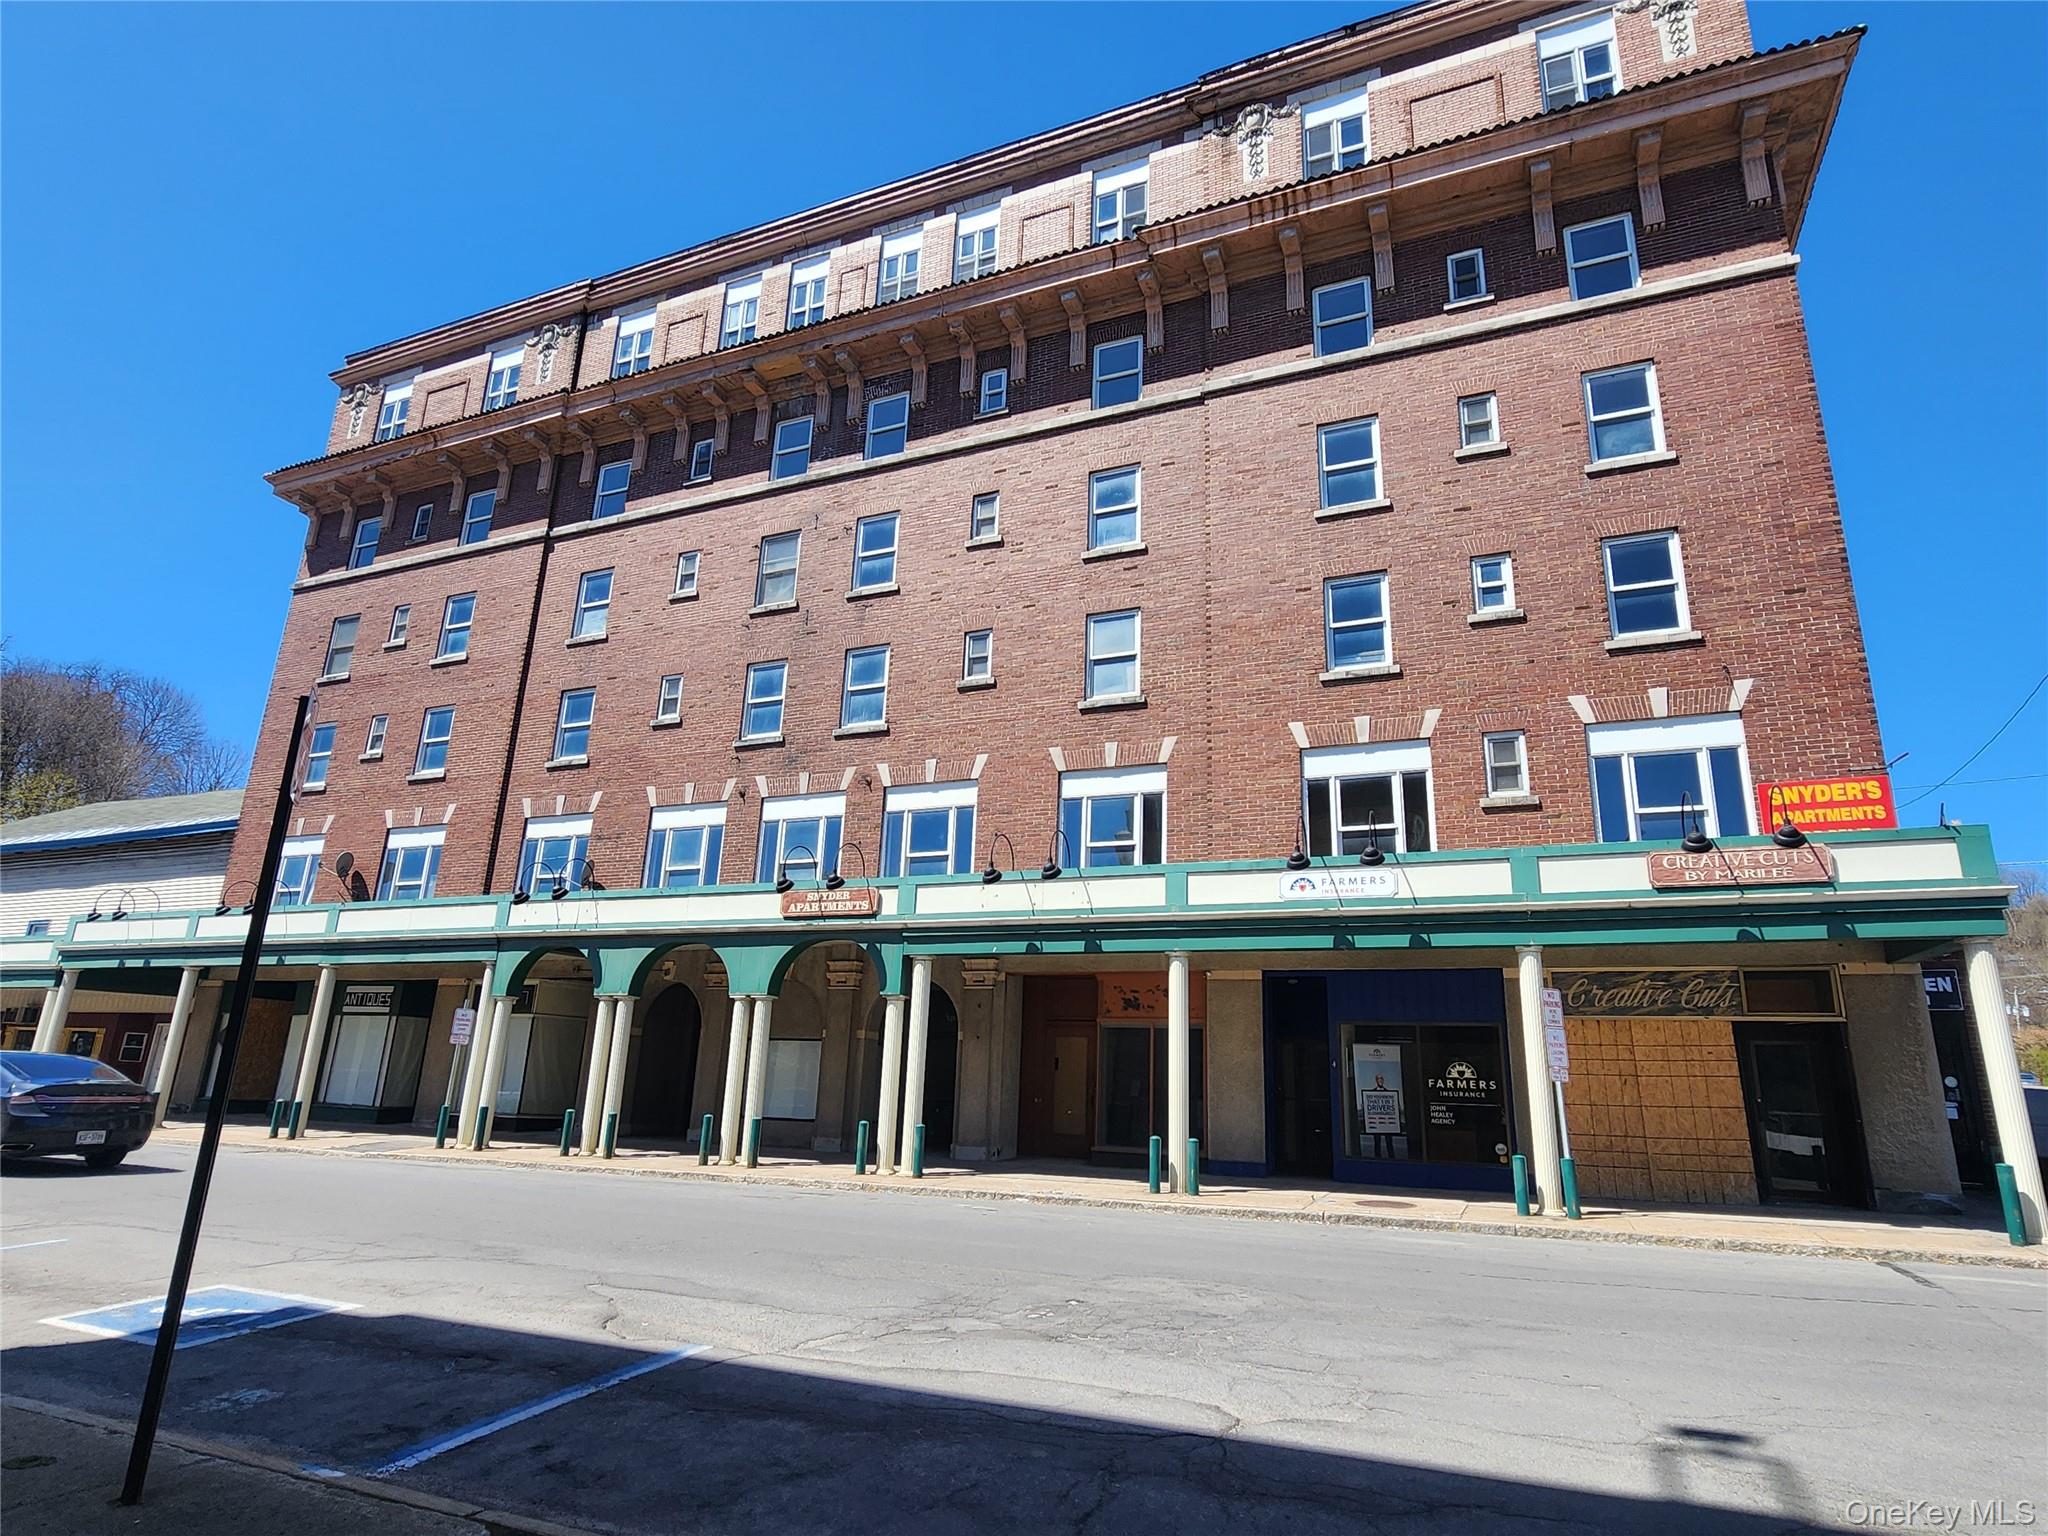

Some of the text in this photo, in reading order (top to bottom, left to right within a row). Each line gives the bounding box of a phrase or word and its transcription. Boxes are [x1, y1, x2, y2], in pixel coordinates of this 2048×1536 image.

[1768, 780, 1882, 806] SNYDER'S
[1773, 805, 1887, 825] APARTMENTS
[1662, 851, 1815, 869] CREATIVE CUTS
[1684, 867, 1795, 881] BY MARILEE
[1321, 876, 1386, 887] FARMERS
[806, 891, 850, 901] SNYDER
[788, 900, 869, 912] APARTMENTS
[1567, 978, 1674, 1007] Creative
[344, 993, 392, 1006] ANTIQUES
[1428, 1079, 1497, 1090] FARMERS
